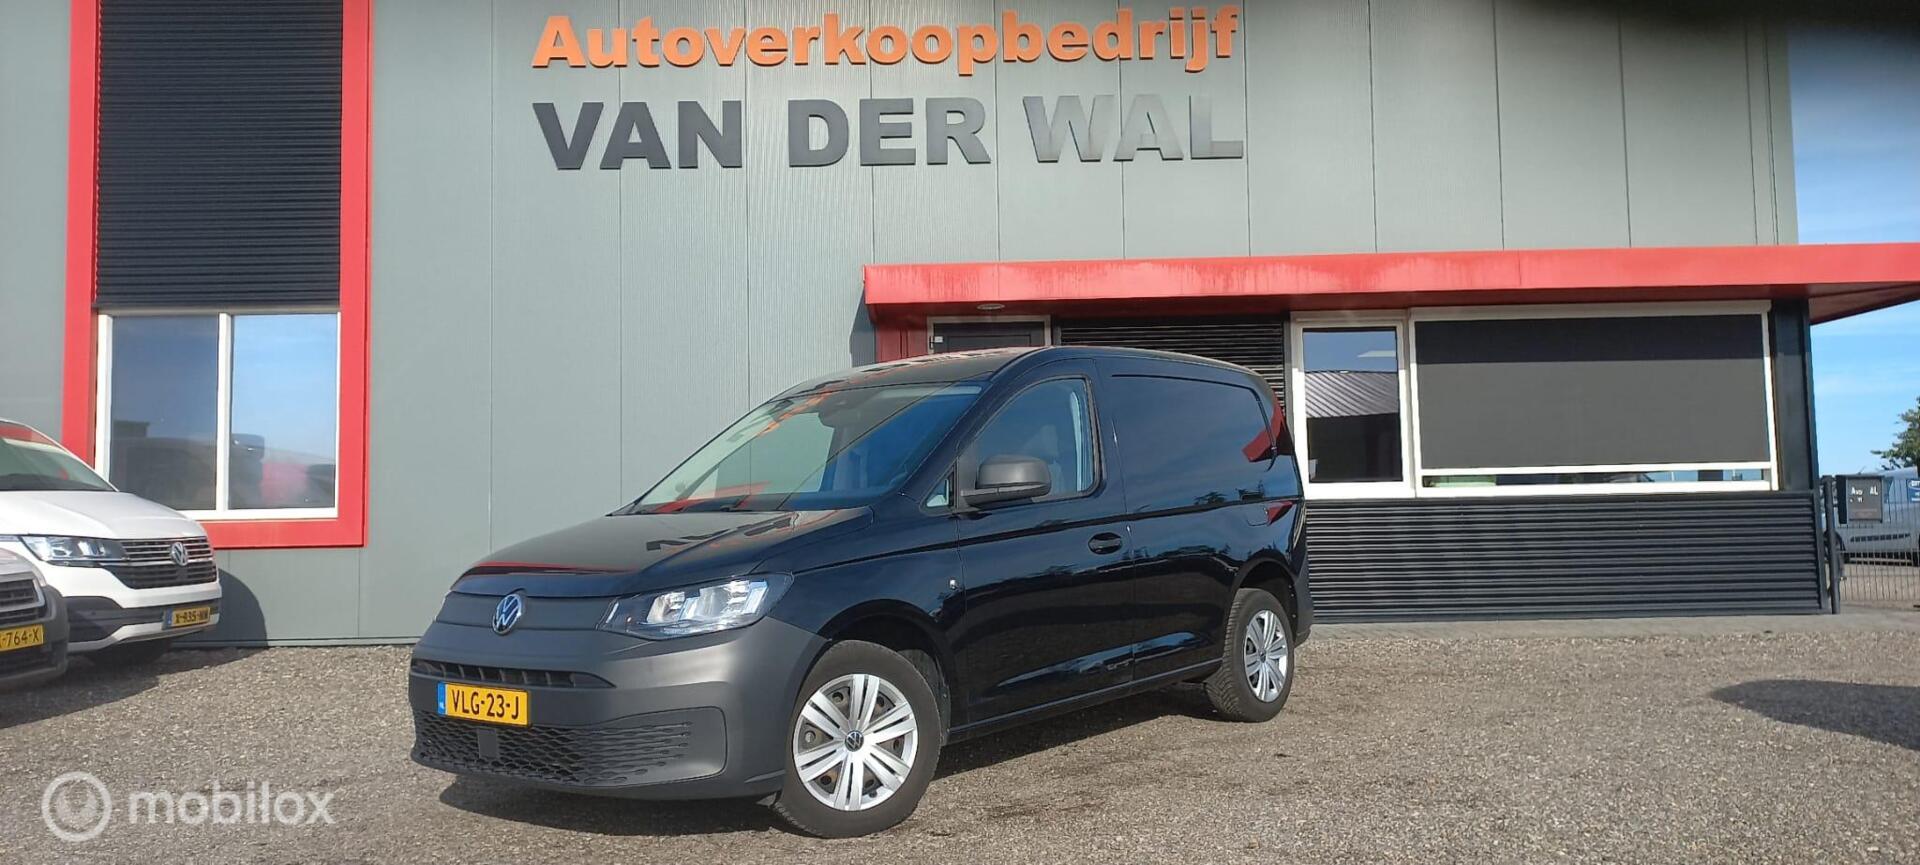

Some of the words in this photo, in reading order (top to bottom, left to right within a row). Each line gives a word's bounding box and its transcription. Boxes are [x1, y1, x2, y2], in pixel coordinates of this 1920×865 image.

[532, 5, 1243, 76] Autoverkoopbedrijf
[533, 101, 742, 169] VAN
[788, 97, 991, 167] DER
[1023, 94, 1244, 162] WAL
[451, 688, 519, 721] VLG-23-J
